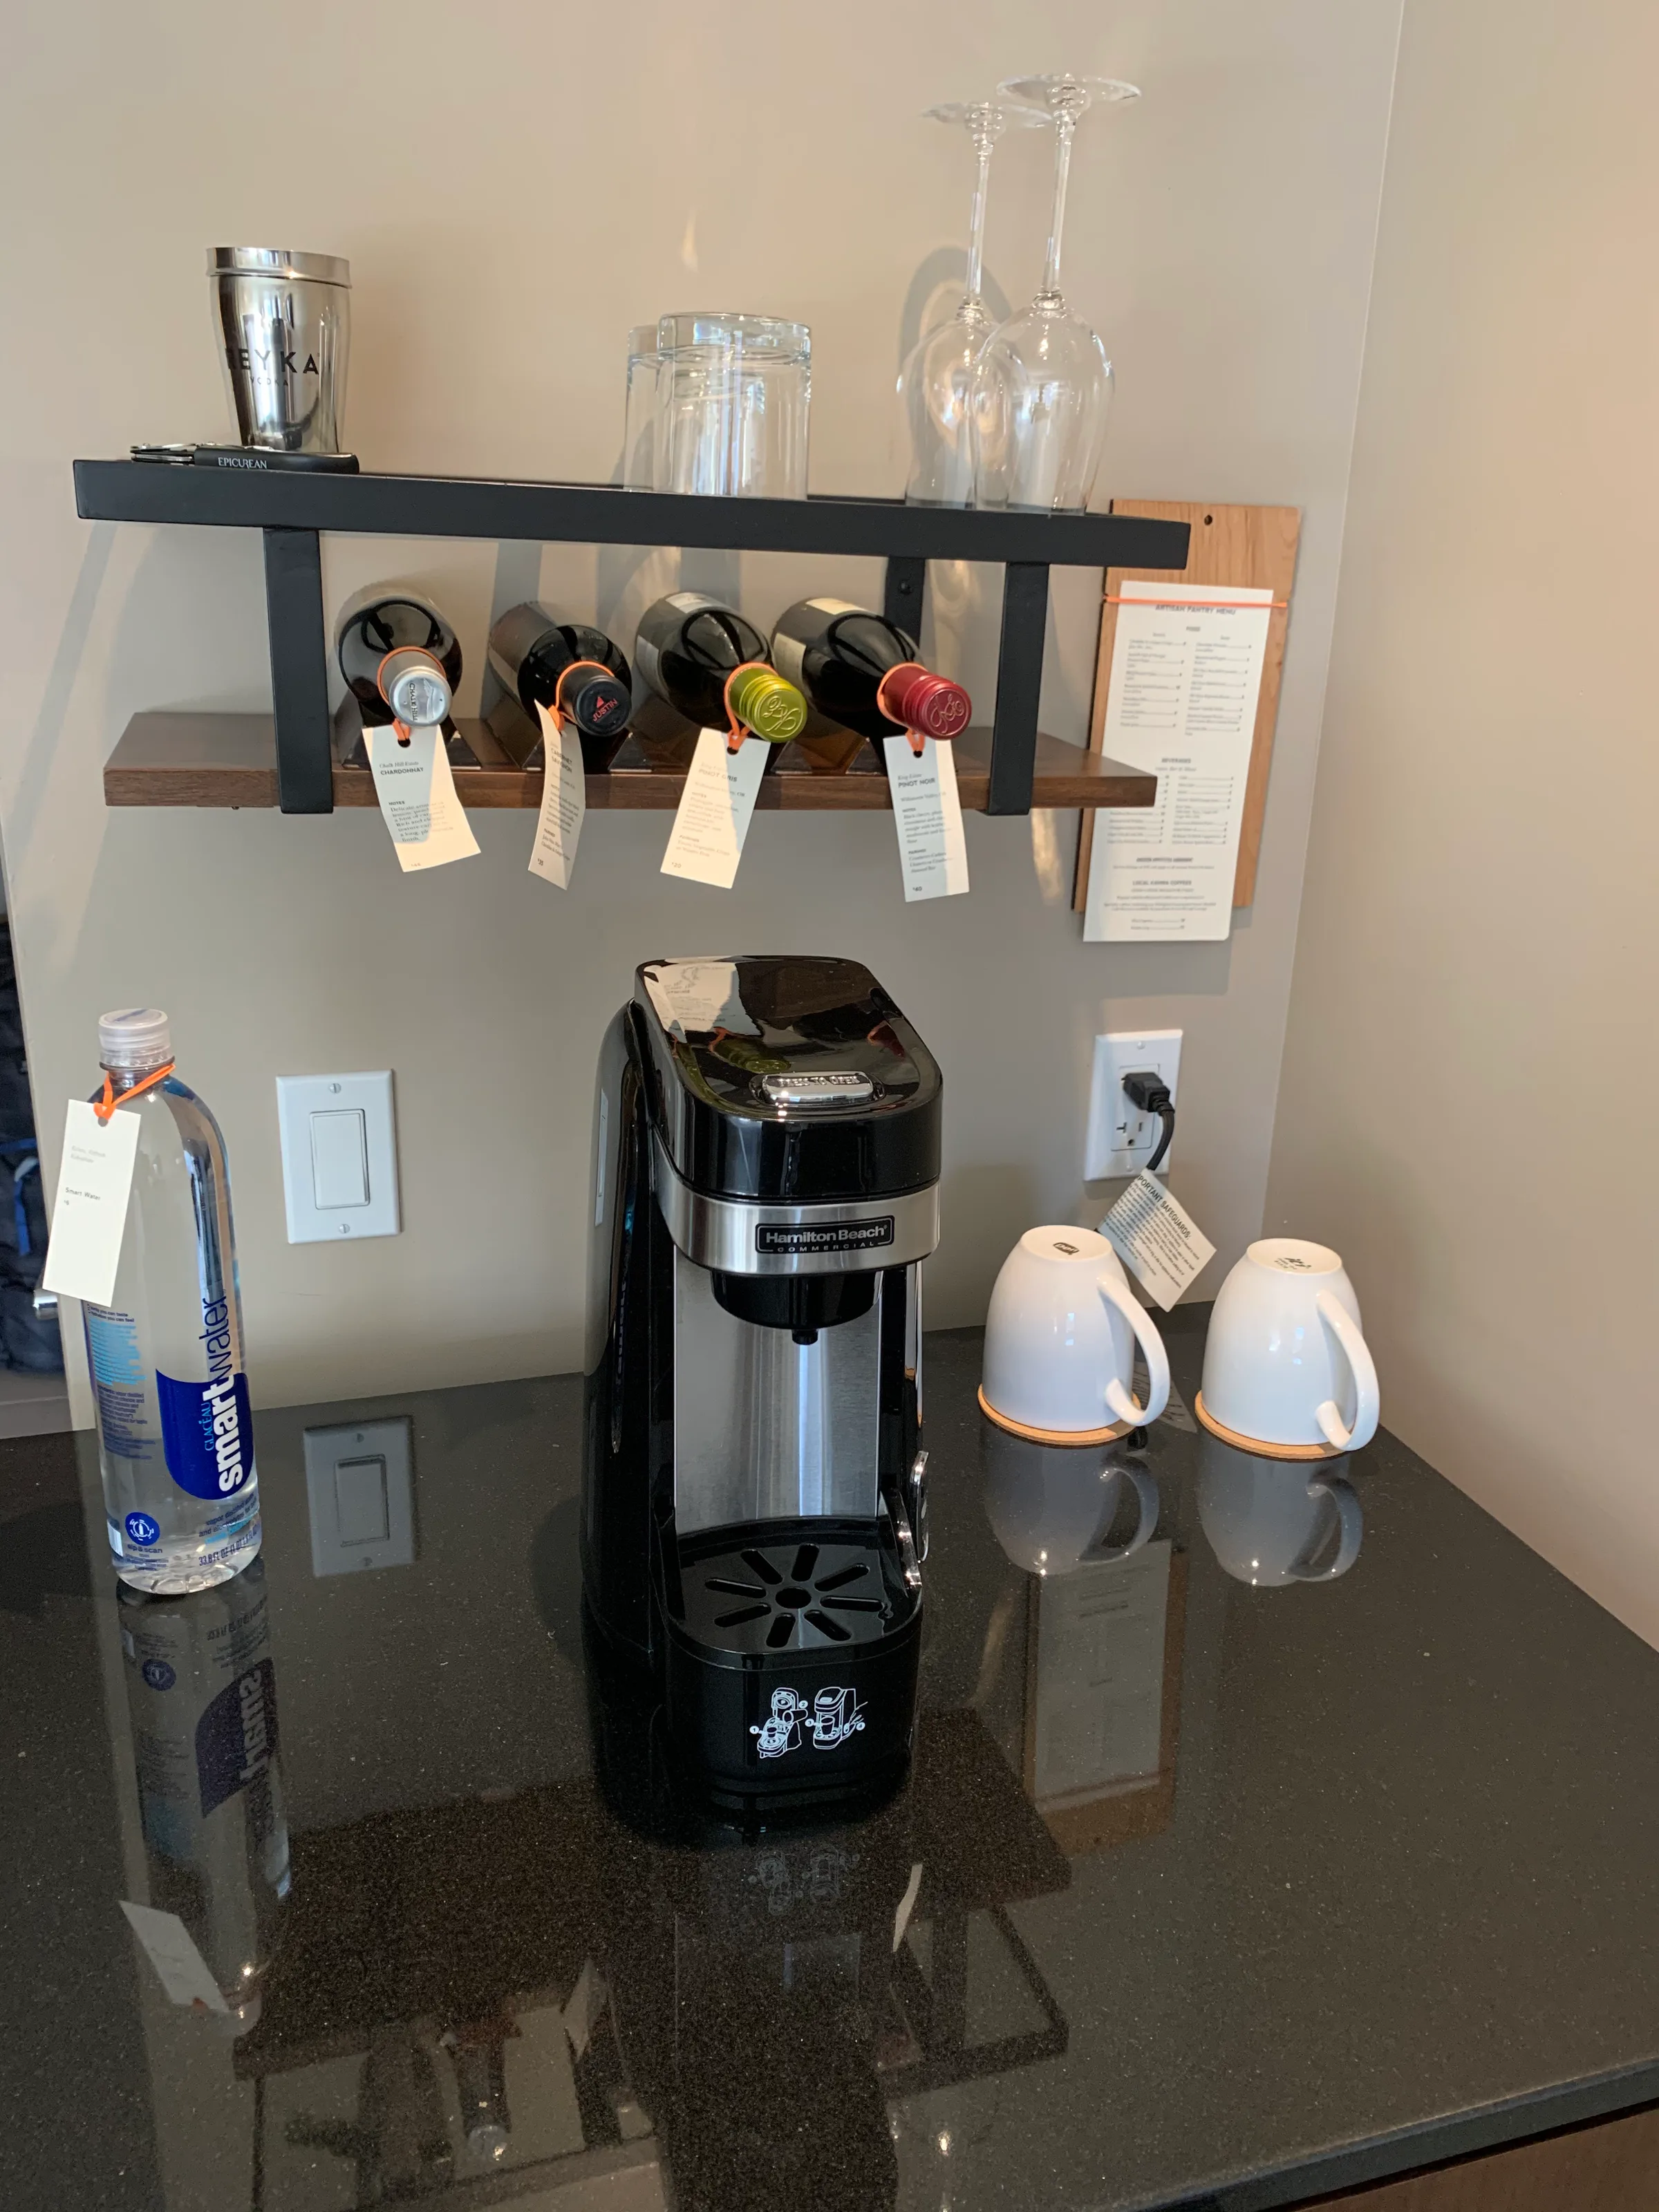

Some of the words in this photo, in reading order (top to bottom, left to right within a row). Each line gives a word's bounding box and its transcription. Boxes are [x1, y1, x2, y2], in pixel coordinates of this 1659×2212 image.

[217, 457, 268, 469] EPICUREAN
[592, 698, 618, 722] JUSTIN
[898, 780, 918, 788] PINOT
[810, 1077, 827, 1086] TO
[830, 1076, 860, 1085] OPEN
[66, 1187, 82, 1196] Smart
[84, 1192, 101, 1201] Water
[1138, 1174, 1163, 1203] PORTANT
[766, 1231, 836, 1244] Hamilton
[838, 1226, 885, 1241] Beach
[777, 1241, 874, 1253] COMMERCIAL
[198, 1528, 212, 1537] and
[198, 1553, 213, 1566] 33.8
